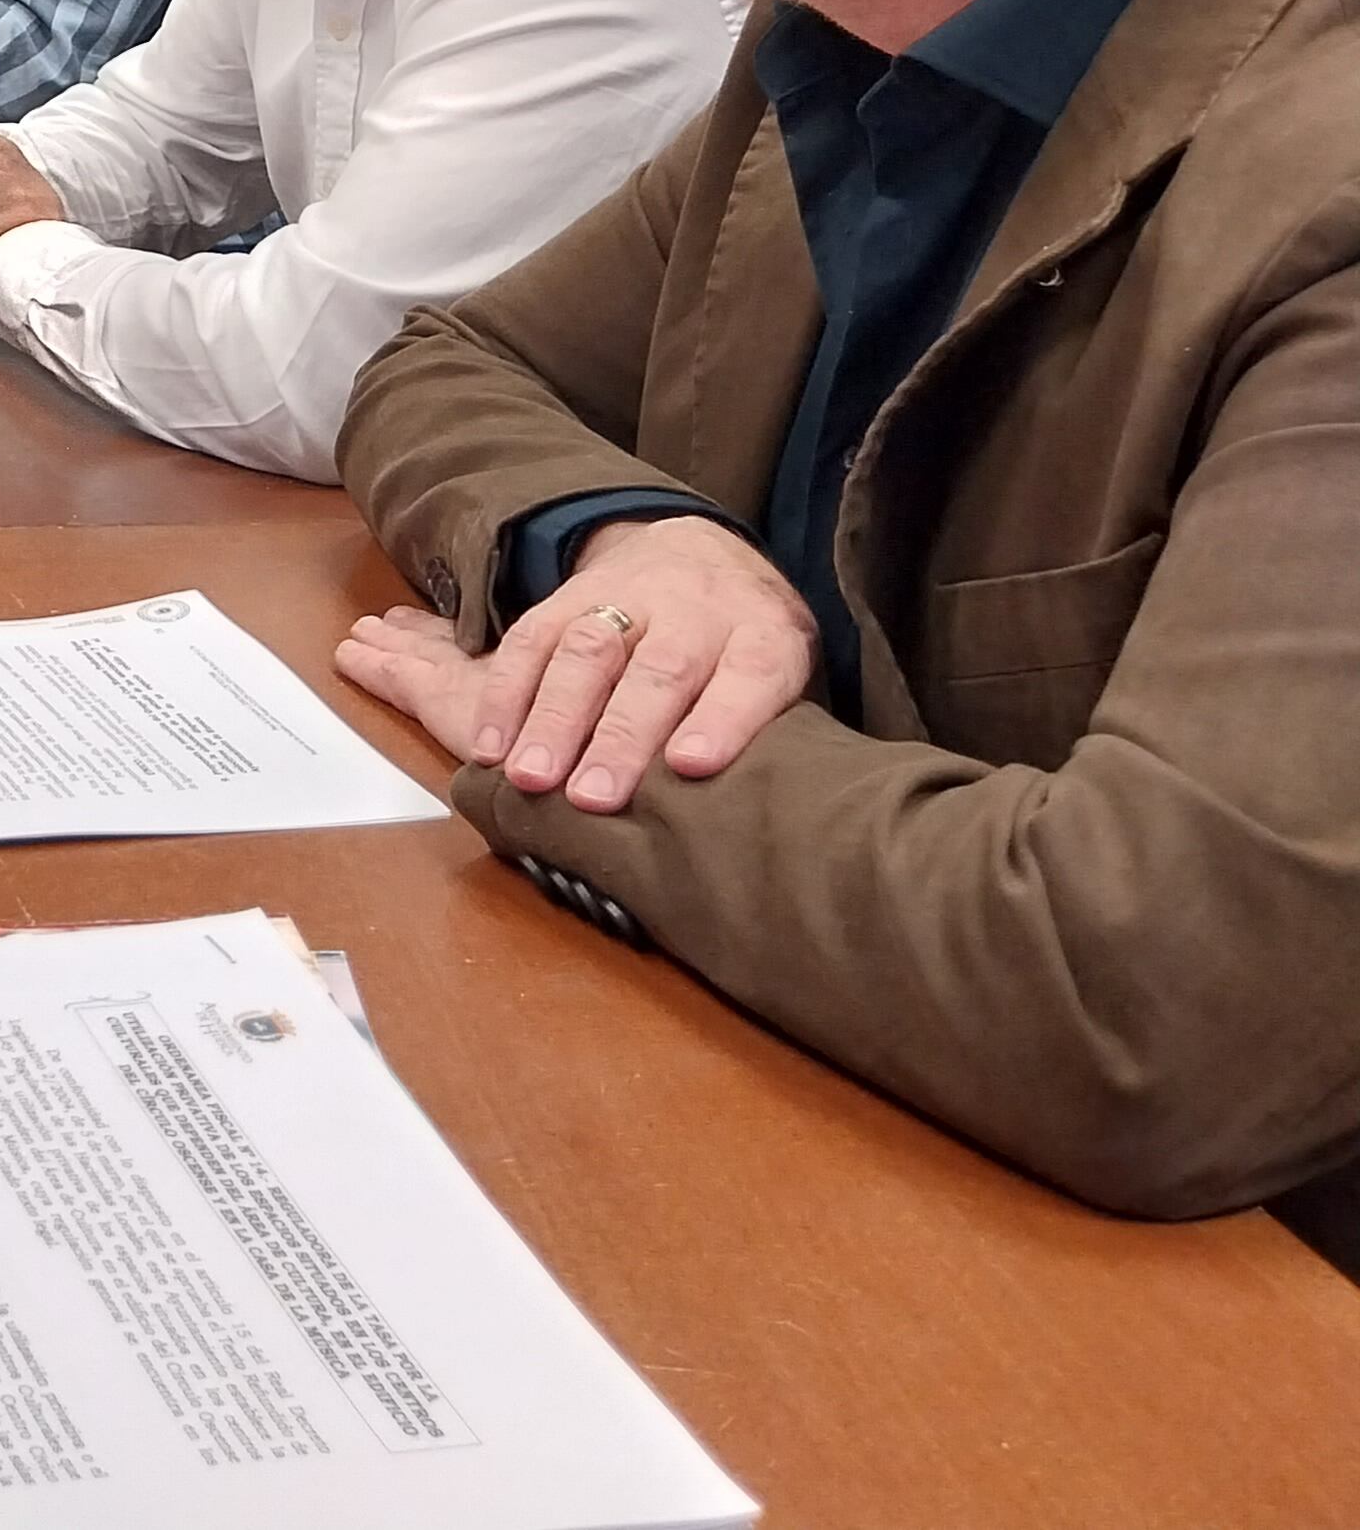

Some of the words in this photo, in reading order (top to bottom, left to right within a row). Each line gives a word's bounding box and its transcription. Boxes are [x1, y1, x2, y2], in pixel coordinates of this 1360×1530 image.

[102, 1016, 165, 1085] CULTURALES
[149, 1087, 182, 1112] QUE
[172, 1113, 228, 1175] DEPENDEN
[218, 1178, 247, 1201] DEL
[237, 1204, 277, 1238] ÁREA
[264, 1241, 288, 1257] DE
[276, 1261, 338, 1327] CULTURA,
[329, 1330, 354, 1348] EN
[344, 1351, 370, 1369] EL
[360, 1373, 421, 1436] EDIFICIO
[119, 1011, 182, 1079] UTILIZACIÓN
[169, 1081, 224, 1141] PRIVATIVA
[214, 1143, 237, 1159] DE
[228, 1162, 256, 1186] LOS
[247, 1189, 301, 1247] ESPACIOS
[292, 1250, 353, 1315] SITUADOS
[343, 1319, 369, 1338] EN
[359, 1341, 392, 1368] LOS
[382, 1371, 446, 1438] CENTROS
[155, 1034, 215, 1100] ORDENANZA
[205, 1102, 245, 1141] FISCAL
[236, 1145, 256, 1158] Nº
[247, 1161, 275, 1182] 14.-
[266, 1186, 340, 1269] REGULADORA
[331, 1273, 356, 1290] DE
[346, 1293, 371, 1310] LA
[362, 1314, 401, 1349] TASA
[391, 1352, 425, 1380] POR
[415, 1383, 442, 1402] LA
